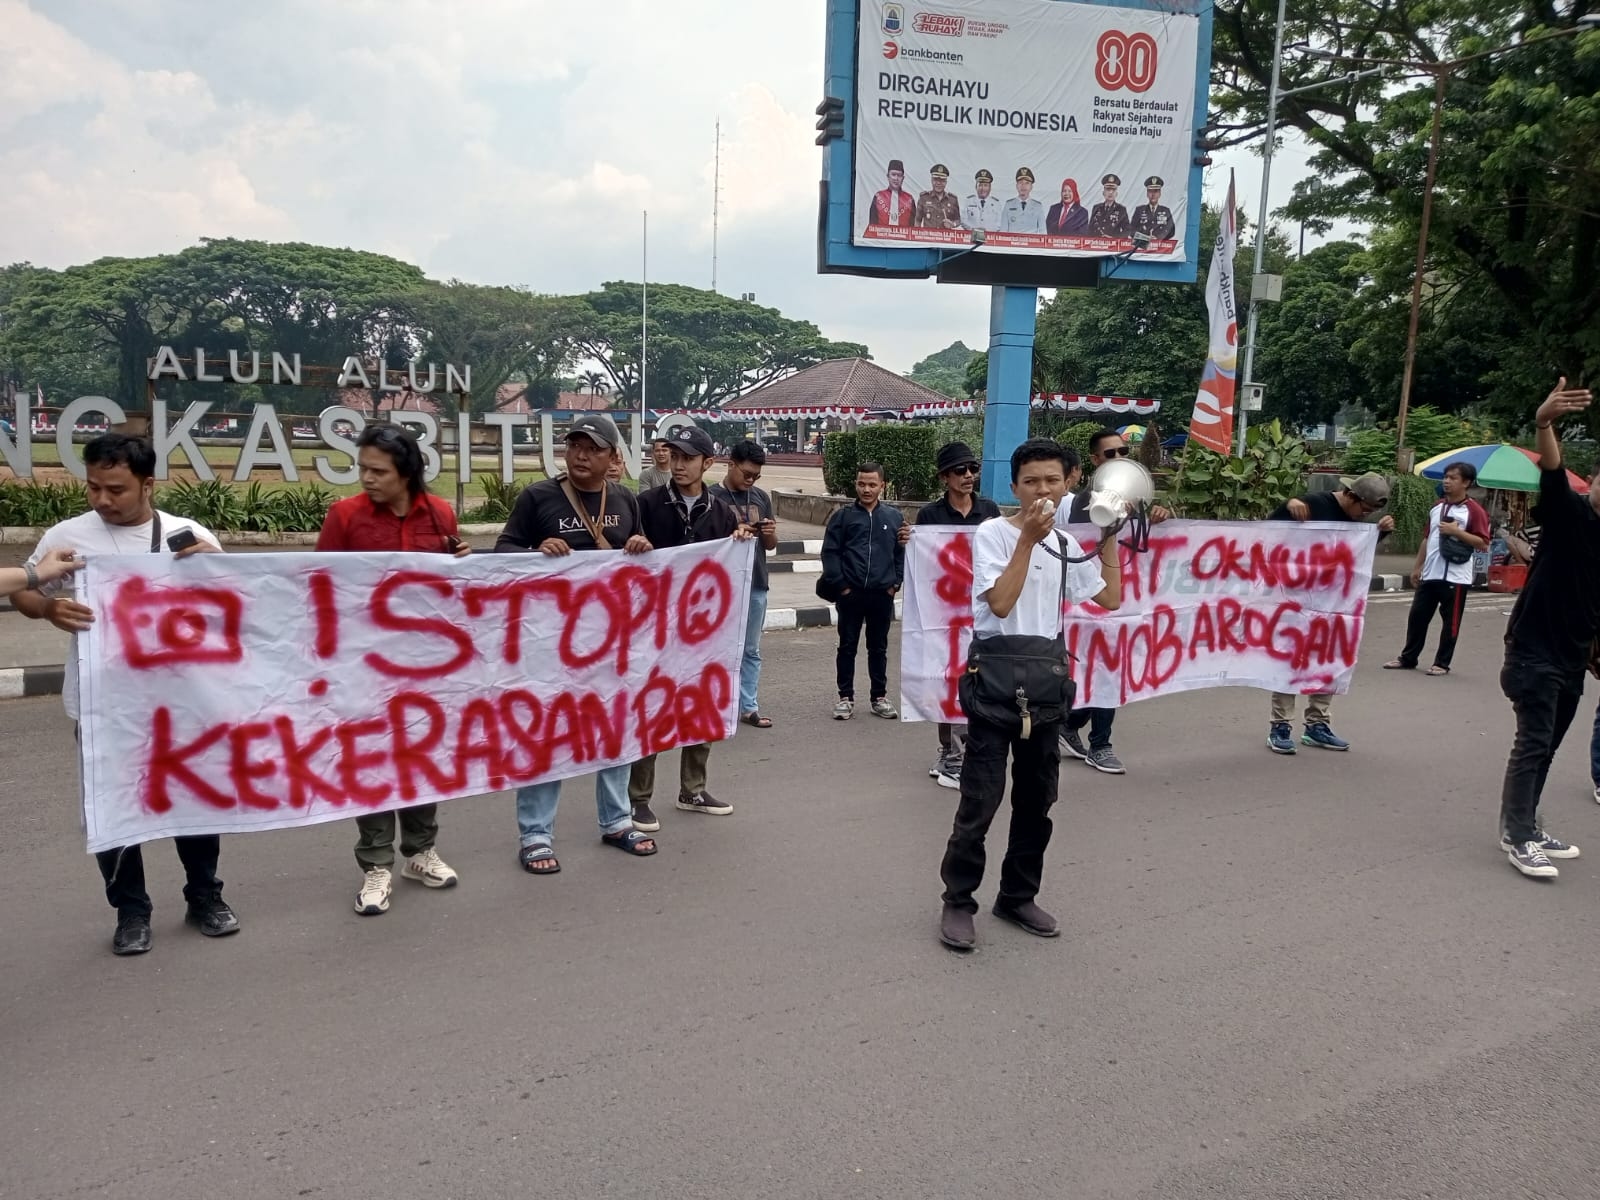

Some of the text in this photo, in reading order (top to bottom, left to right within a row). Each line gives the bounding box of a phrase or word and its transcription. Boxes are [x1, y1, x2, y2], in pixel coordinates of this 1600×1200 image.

[924, 15, 958, 26] LEBAK
[901, 46, 964, 62] bankbanten
[1095, 29, 1157, 93] 80
[879, 72, 989, 99] DIRGAHAYU
[878, 98, 1078, 132] REPUBLIK INDONESIA
[1093, 109, 1173, 125] Rakyat Sejahtera
[1094, 96, 1178, 111] Bersatu Berdaulat
[1093, 123, 1162, 139] Indonesia Maju
[149, 345, 472, 394] ALUN ALUN
[1191, 534, 1356, 598] OKNUM
[1189, 597, 1364, 670] AROGAN
[143, 690, 629, 813] KEKERASAN
